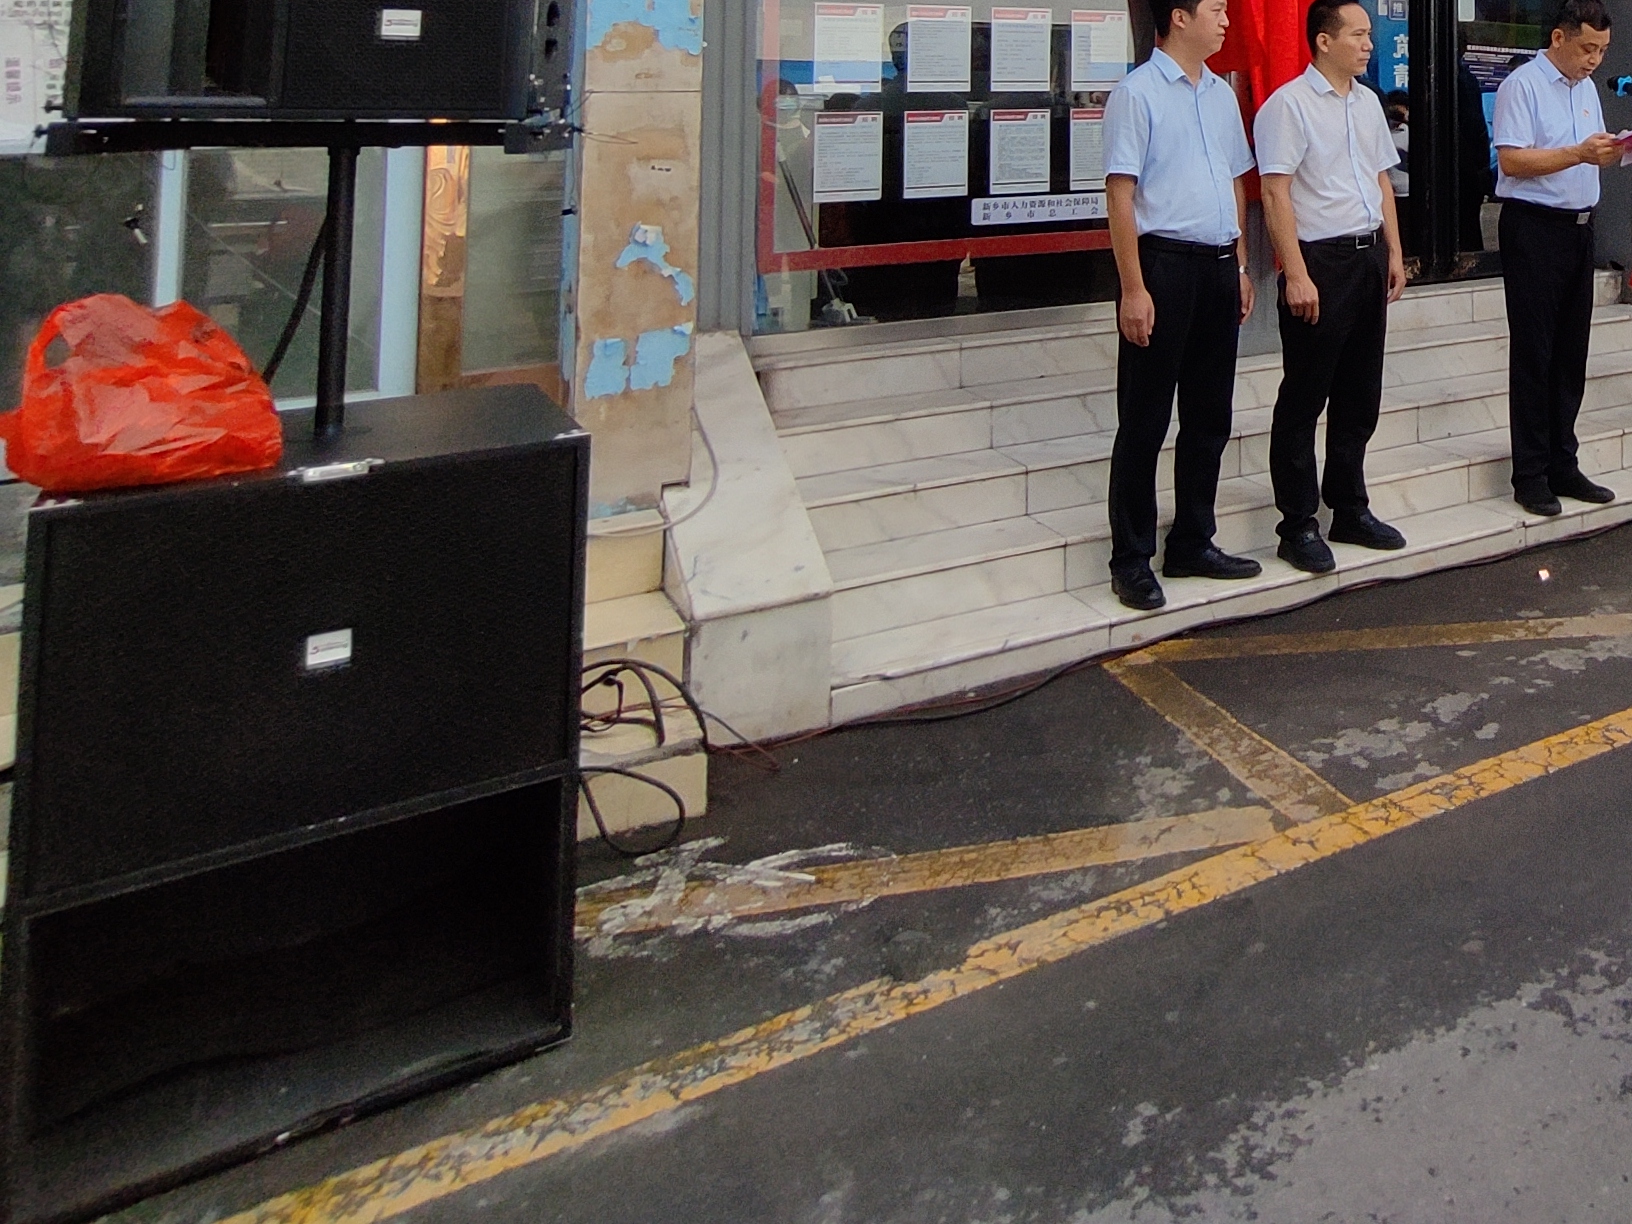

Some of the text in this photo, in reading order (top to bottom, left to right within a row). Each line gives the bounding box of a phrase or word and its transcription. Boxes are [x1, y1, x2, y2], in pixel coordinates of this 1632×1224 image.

[982, 196, 1100, 212] 新乡市人力资源和社会保障局
[982, 207, 1100, 222] 新乡市总工会
